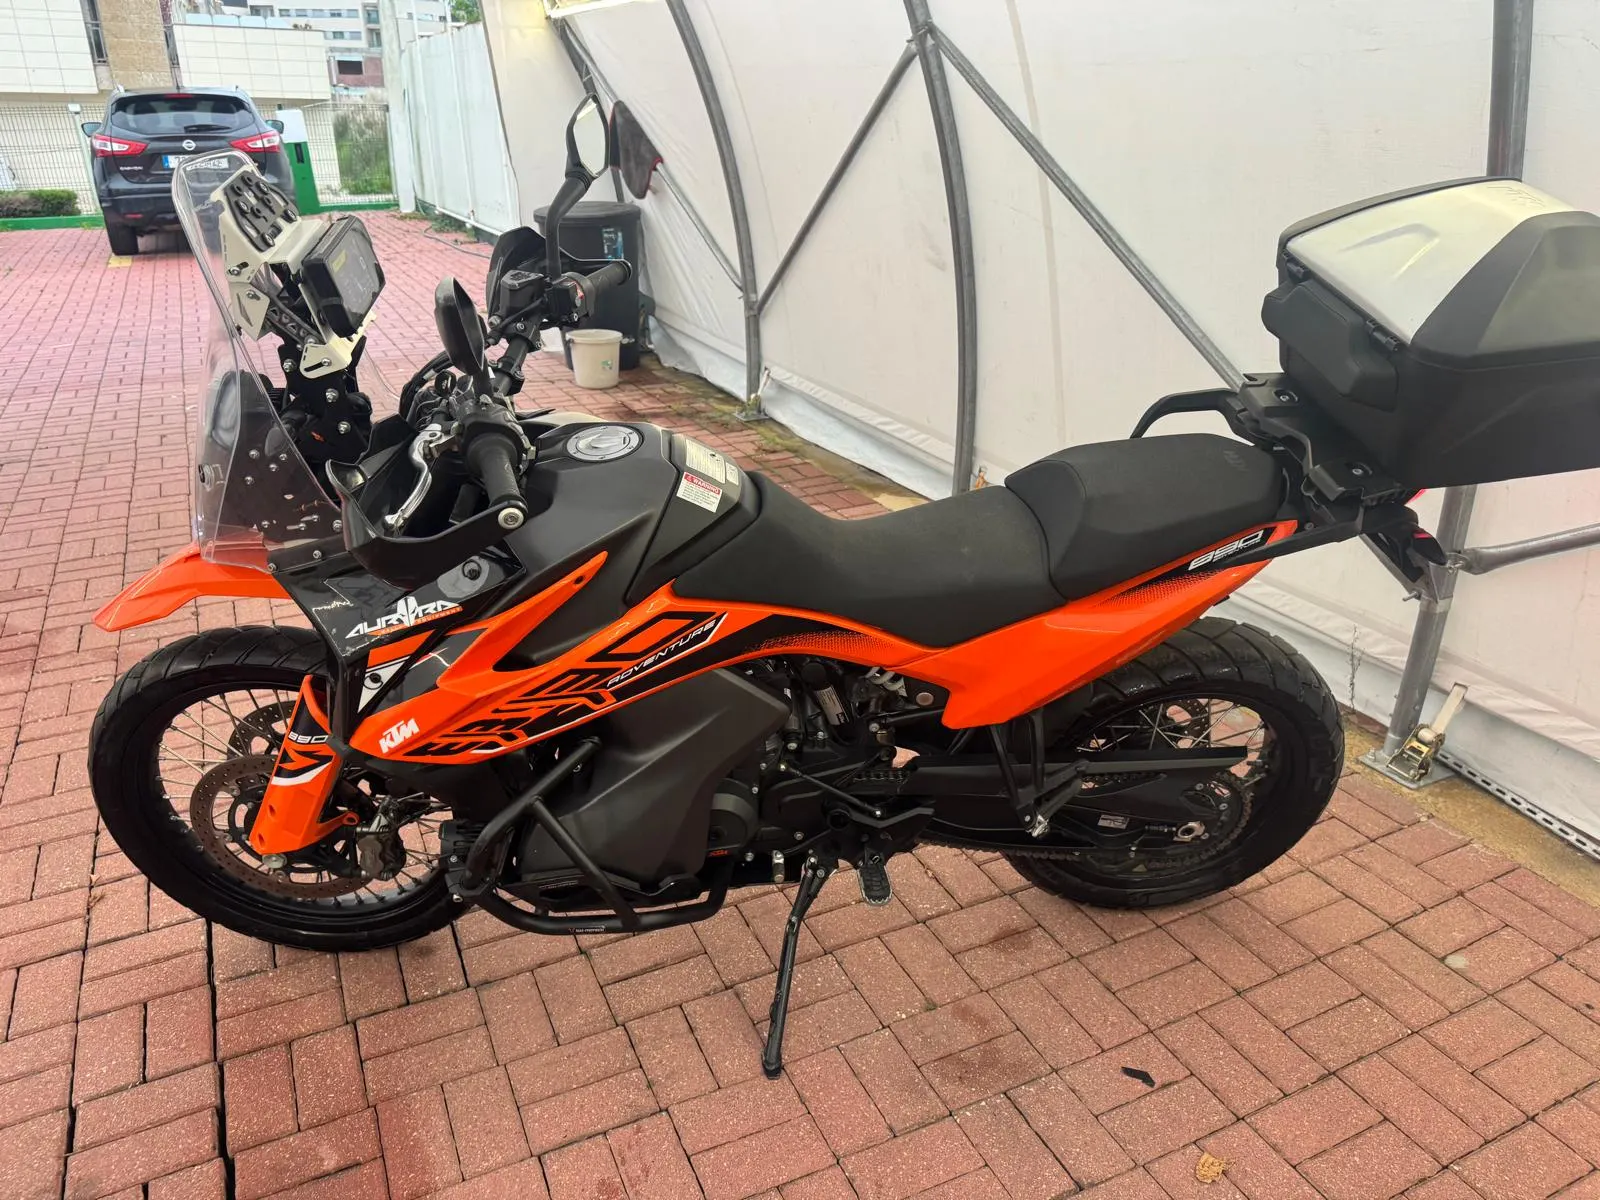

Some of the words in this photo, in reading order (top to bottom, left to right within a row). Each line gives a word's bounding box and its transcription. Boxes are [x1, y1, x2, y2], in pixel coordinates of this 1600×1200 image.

[693, 477, 719, 494] WARNING
[606, 619, 716, 688] ADVENTURE
[288, 731, 329, 744] 890
[378, 718, 420, 754] KTM
